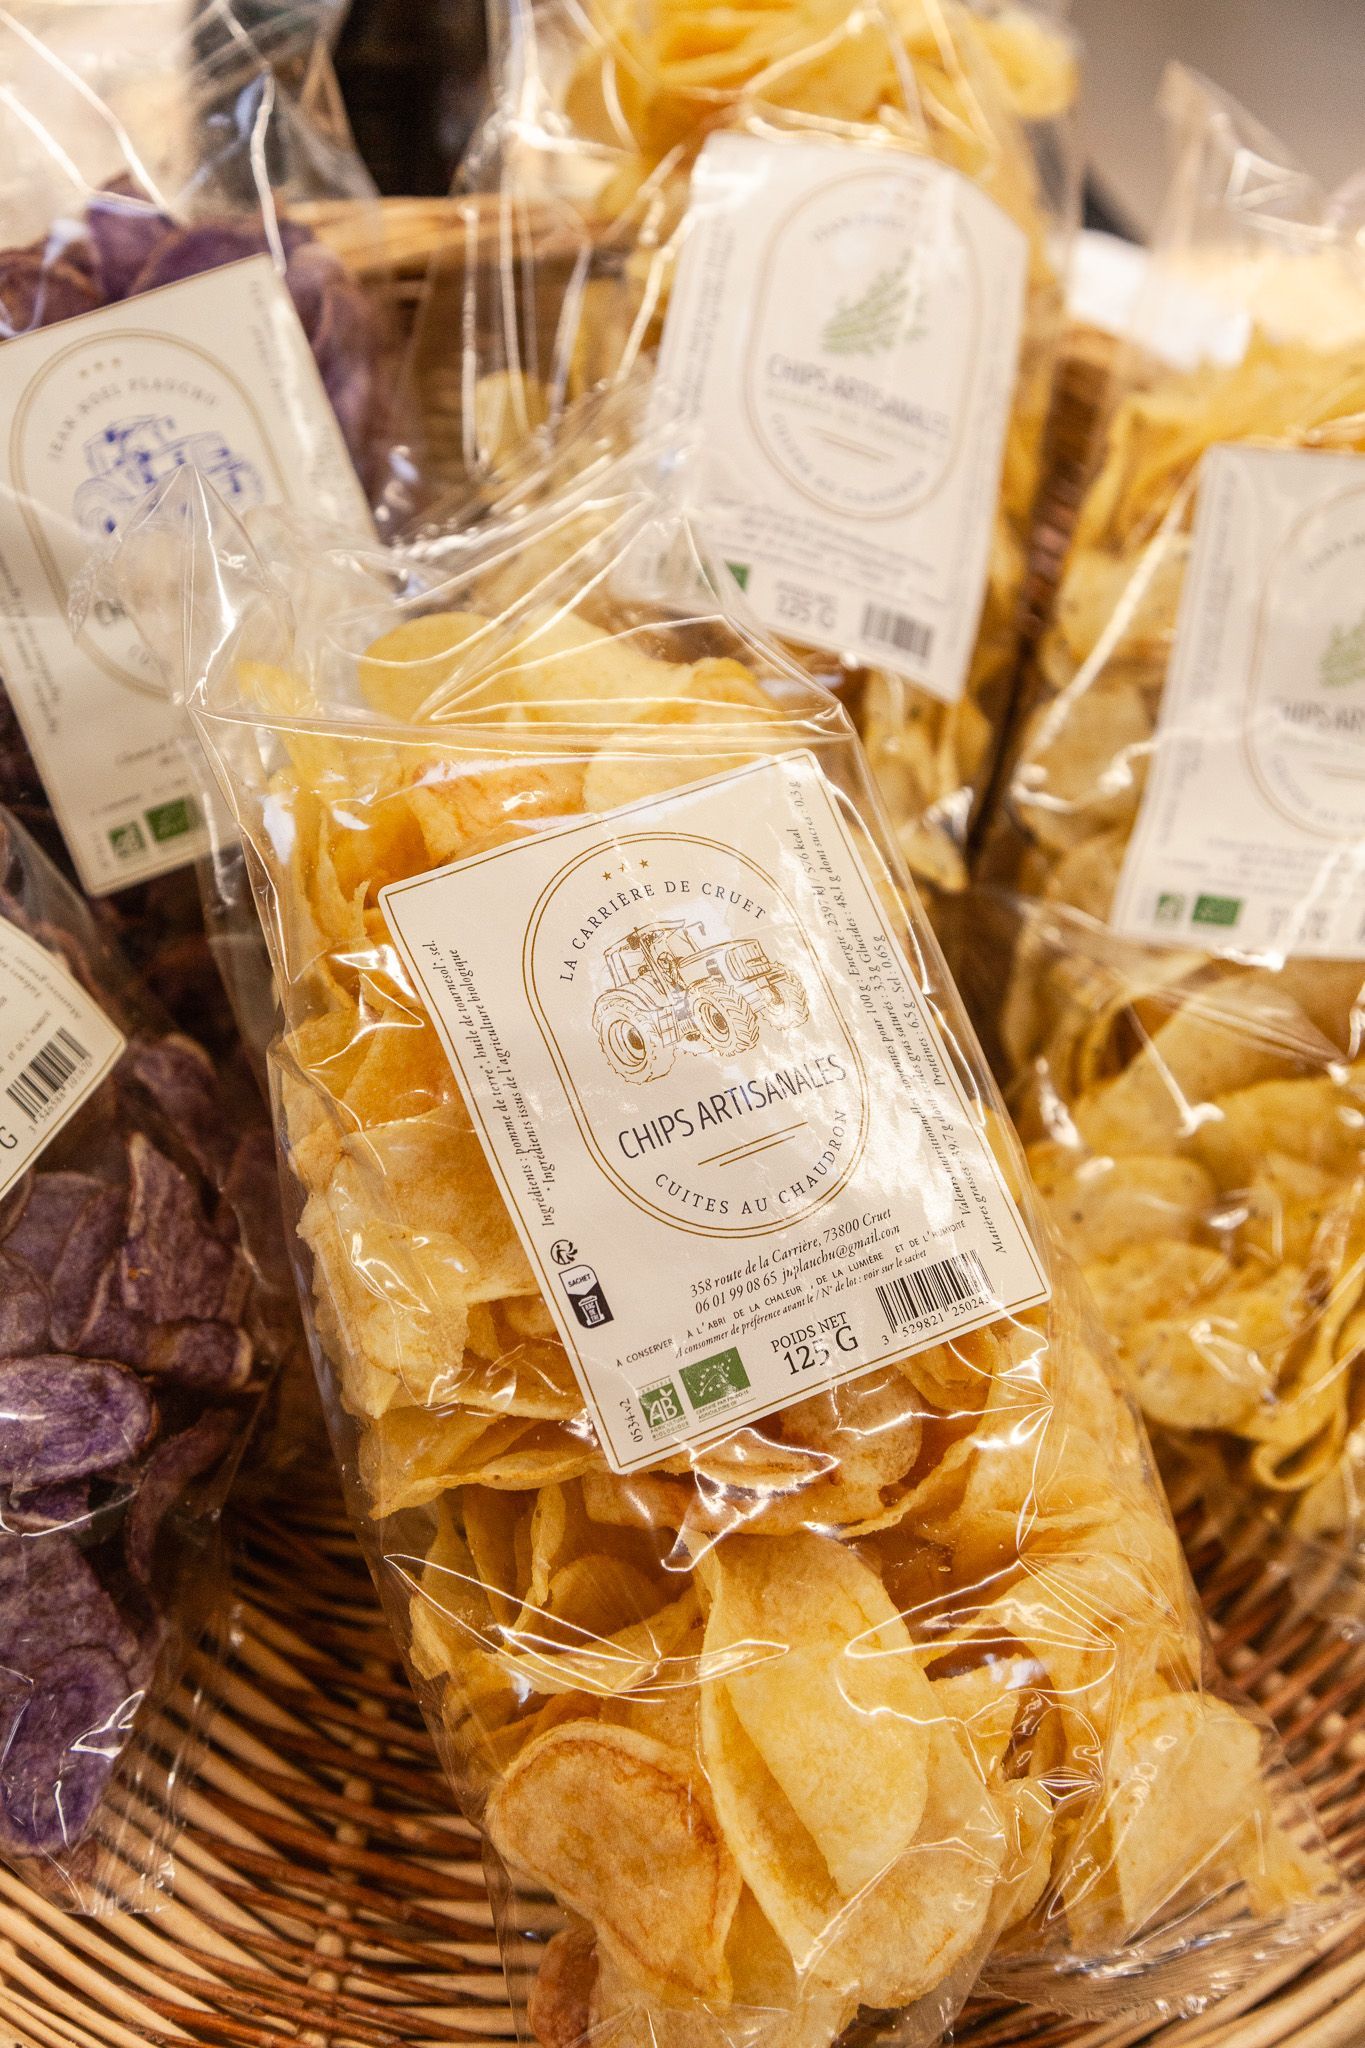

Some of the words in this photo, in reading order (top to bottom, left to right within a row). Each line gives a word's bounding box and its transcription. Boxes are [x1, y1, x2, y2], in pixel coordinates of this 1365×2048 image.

[786, 828, 805, 849] kcal
[816, 849, 832, 873] dont
[828, 874, 841, 882] g
[559, 960, 577, 981] LA
[572, 884, 654, 949] CARRIÈRE
[663, 880, 690, 892] DE
[701, 882, 765, 918] CRUET
[846, 918, 871, 963] Glucides
[872, 934, 885, 942] g
[421, 940, 440, 955] sel.
[836, 936, 860, 975] Energie
[449, 949, 480, 1002] biologique
[867, 964, 880, 972] g
[868, 974, 885, 991] 3,3
[886, 977, 904, 992] Sel
[859, 994, 876, 1013] 100
[458, 1014, 474, 1026] de
[873, 1017, 894, 1042] pour
[882, 1001, 905, 1037] saturés
[903, 1011, 919, 1028] 6,5
[465, 1030, 486, 1058] huile
[901, 1040, 921, 1061] gras
[918, 1037, 945, 1085] Protéines
[502, 1076, 517, 1089] de
[492, 1099, 508, 1111] de
[511, 1092, 528, 1117] issus
[618, 1108, 694, 1158] CHIPS
[697, 1056, 845, 1128] ARTISANALES
[502, 1115, 530, 1154] pomme
[941, 1123, 953, 1131] g
[655, 1173, 728, 1214] CUITES
[741, 1197, 767, 1214] AU
[778, 1110, 845, 1203] CHAUDRON
[521, 1164, 554, 1225] Ingrédients
[950, 1176, 970, 1214] Valeurs
[961, 1167, 986, 1203] grasses
[978, 1205, 1006, 1253] Matières
[690, 1278, 712, 1297] 358
[714, 1269, 741, 1287] route
[744, 1259, 756, 1275] de
[758, 1255, 769, 1269] la
[771, 1238, 821, 1262] Carrière,
[822, 1218, 859, 1242] 73800
[862, 1208, 890, 1226] Cruet
[567, 1273, 590, 1287] SACHET
[695, 1297, 710, 1314] 06
[712, 1291, 725, 1307] 01
[729, 1284, 743, 1301] 99
[746, 1277, 760, 1293] 08
[762, 1270, 777, 1286] 65
[625, 1338, 673, 1363] CONSERVER
[732, 1308, 744, 1319] DE
[748, 1303, 760, 1312] LA
[764, 1285, 802, 1305] CHALEUR
[815, 1274, 827, 1285] DE
[831, 1268, 843, 1278] LA
[847, 1252, 883, 1271] LUMIÈRE
[894, 1243, 904, 1253] ET
[908, 1237, 919, 1247] DE
[684, 1330, 728, 1354] consommer
[730, 1323, 739, 1335] de
[741, 1309, 780, 1334] préférence
[782, 1298, 805, 1313] avant
[806, 1293, 813, 1303] le
[834, 1280, 844, 1292] de
[845, 1276, 856, 1287] lot
[863, 1268, 879, 1280] voir
[881, 1262, 893, 1273] sur
[895, 1256, 902, 1267] le
[904, 1249, 926, 1264] sachet
[770, 1324, 816, 1352] POIDS
[817, 1311, 846, 1333] NET
[881, 1334, 889, 1345] 3
[902, 1315, 944, 1337] 529821
[783, 1338, 830, 1376] 125
[835, 1325, 858, 1351] G
[649, 1397, 678, 1426] AB
